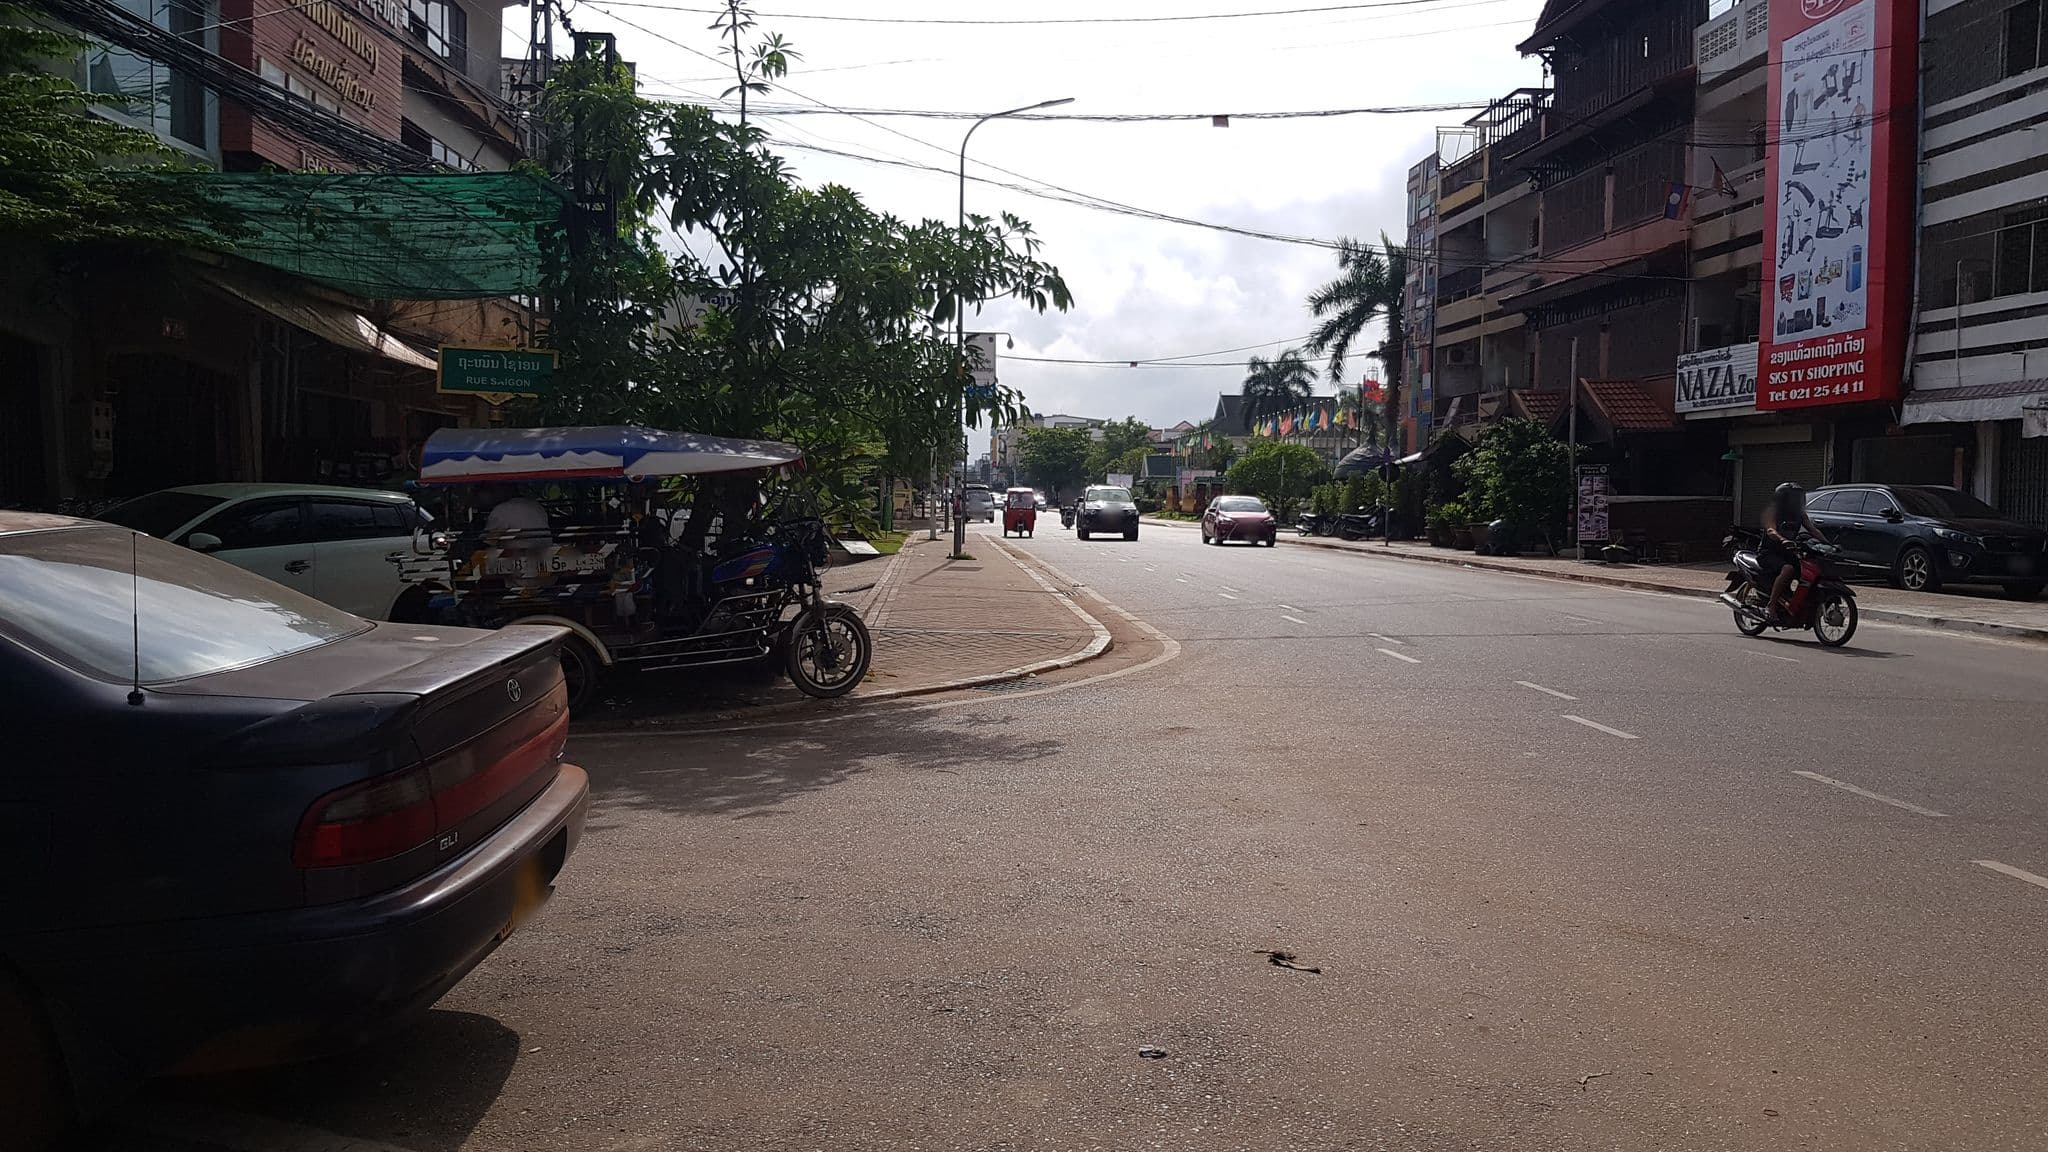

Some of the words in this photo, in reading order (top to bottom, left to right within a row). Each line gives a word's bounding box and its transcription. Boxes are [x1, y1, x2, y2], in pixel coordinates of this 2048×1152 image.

[466, 376, 488, 385] RUE
[490, 377, 531, 387] SAIGON
[1677, 365, 1736, 402] NAZA
[1769, 371, 1788, 385] SKS
[1791, 368, 1805, 383] TV
[1807, 359, 1865, 380] SHOPPING
[1789, 387, 1810, 400] 021
[1814, 384, 1830, 398] 25
[1832, 382, 1849, 395] 44
[1852, 379, 1864, 392] 11
